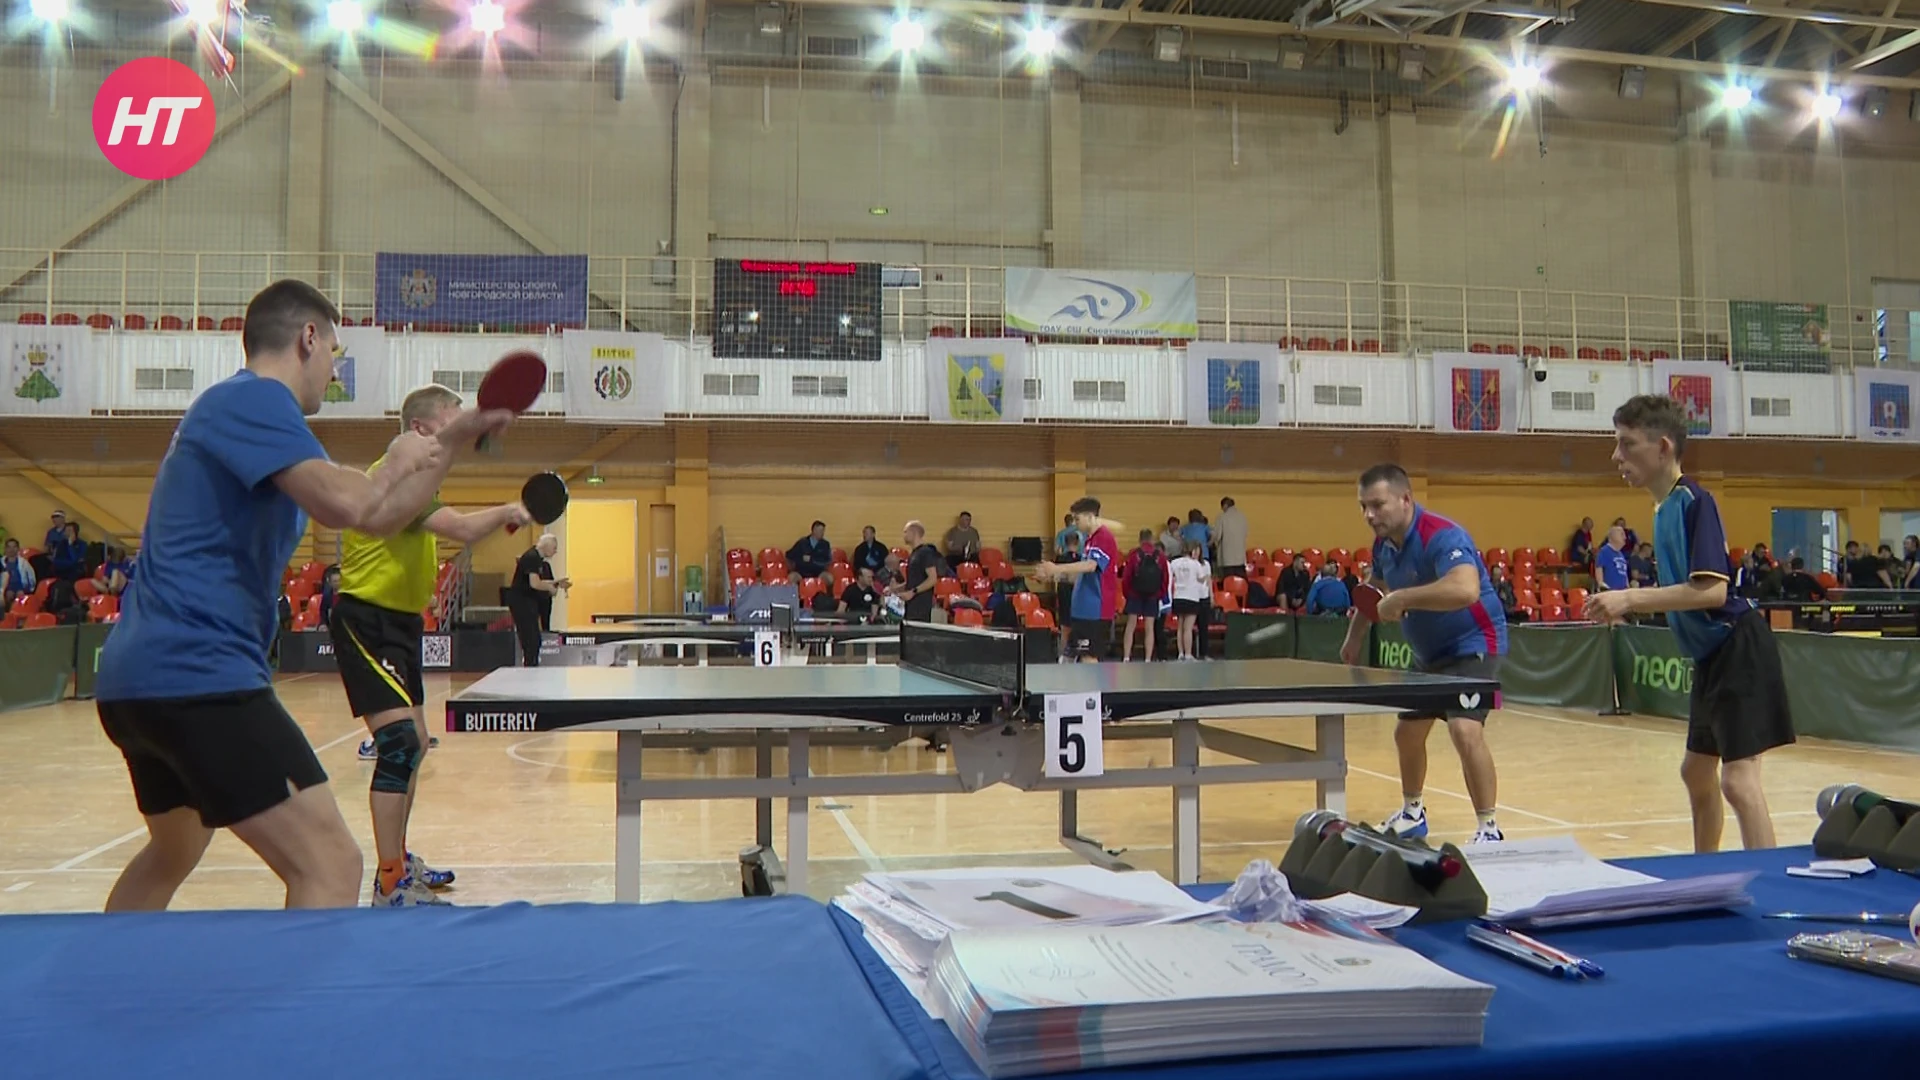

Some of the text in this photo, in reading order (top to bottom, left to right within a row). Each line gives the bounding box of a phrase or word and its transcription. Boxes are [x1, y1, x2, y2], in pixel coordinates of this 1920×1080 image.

[448, 281, 558, 290] МИНИСТЕРСТВО СПОРТА
[448, 291, 564, 300] НОВГОРОДСКОЙ ОБЛАСТИ
[761, 641, 773, 665] 6
[465, 712, 537, 731] BUTTERFLY
[904, 712, 962, 722] Centrefold 25
[1059, 715, 1086, 773] 5
